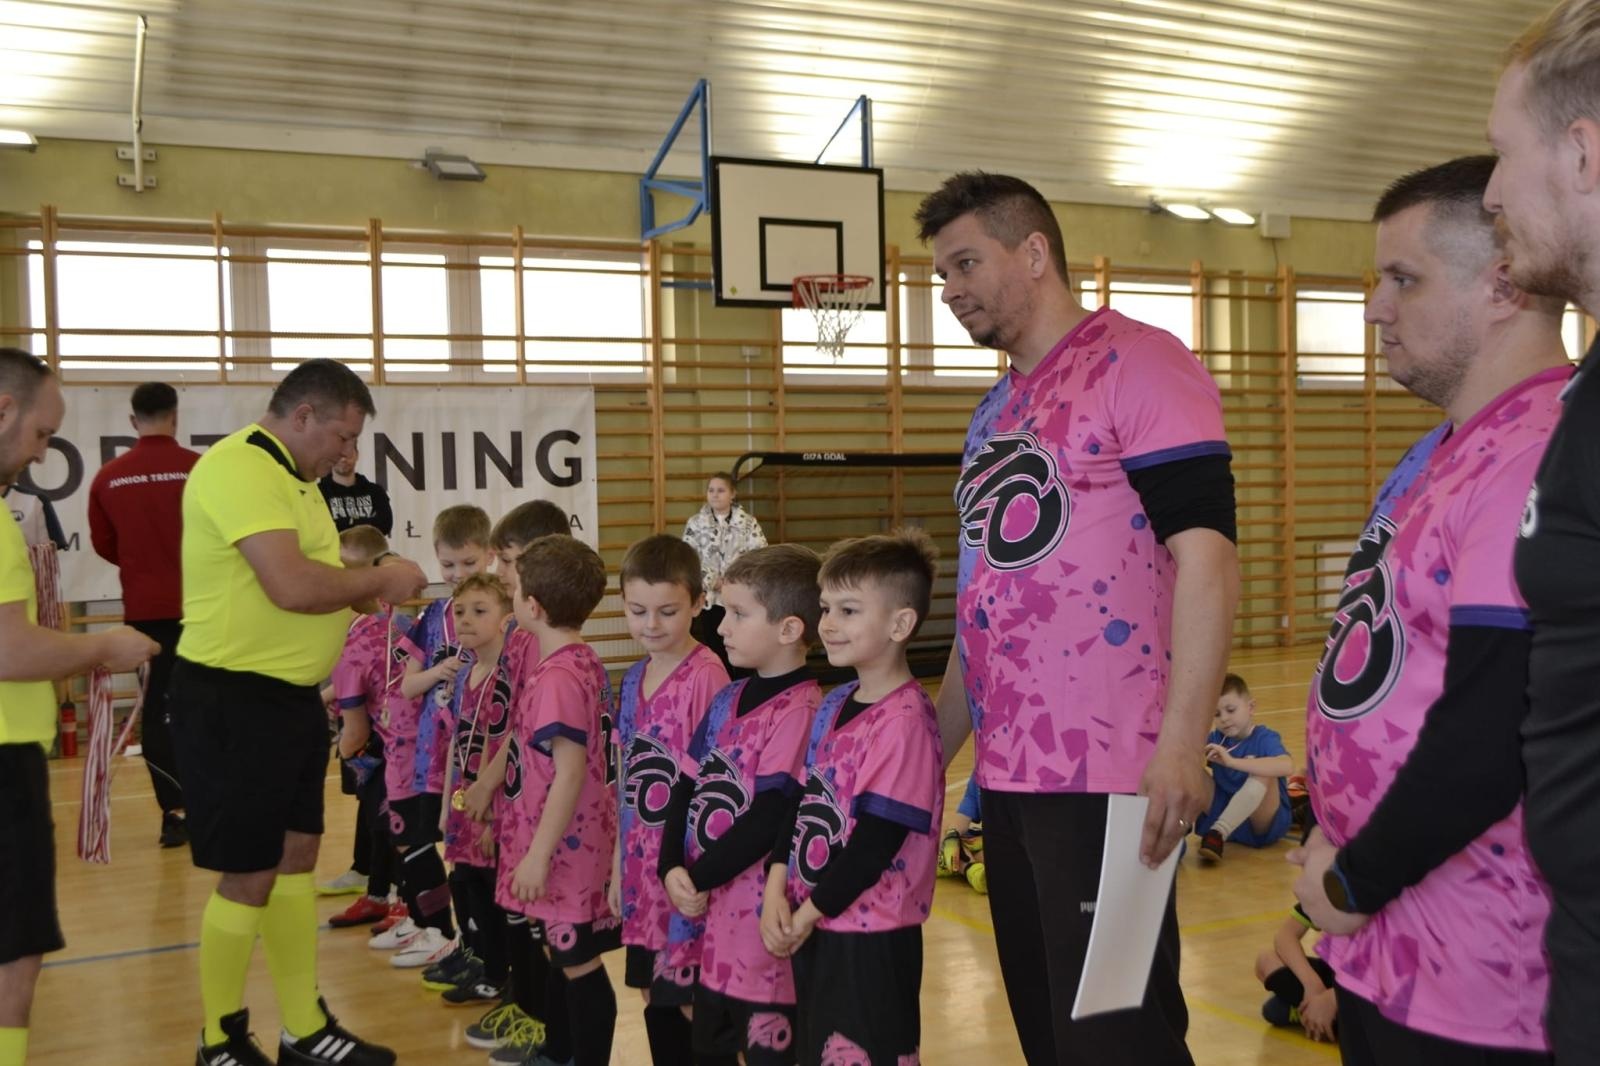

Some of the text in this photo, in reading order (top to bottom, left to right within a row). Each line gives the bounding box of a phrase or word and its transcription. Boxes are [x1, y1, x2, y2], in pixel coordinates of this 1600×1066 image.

[823, 453, 847, 461] GOAL
[109, 472, 189, 488] JUNIOR TRENIN
